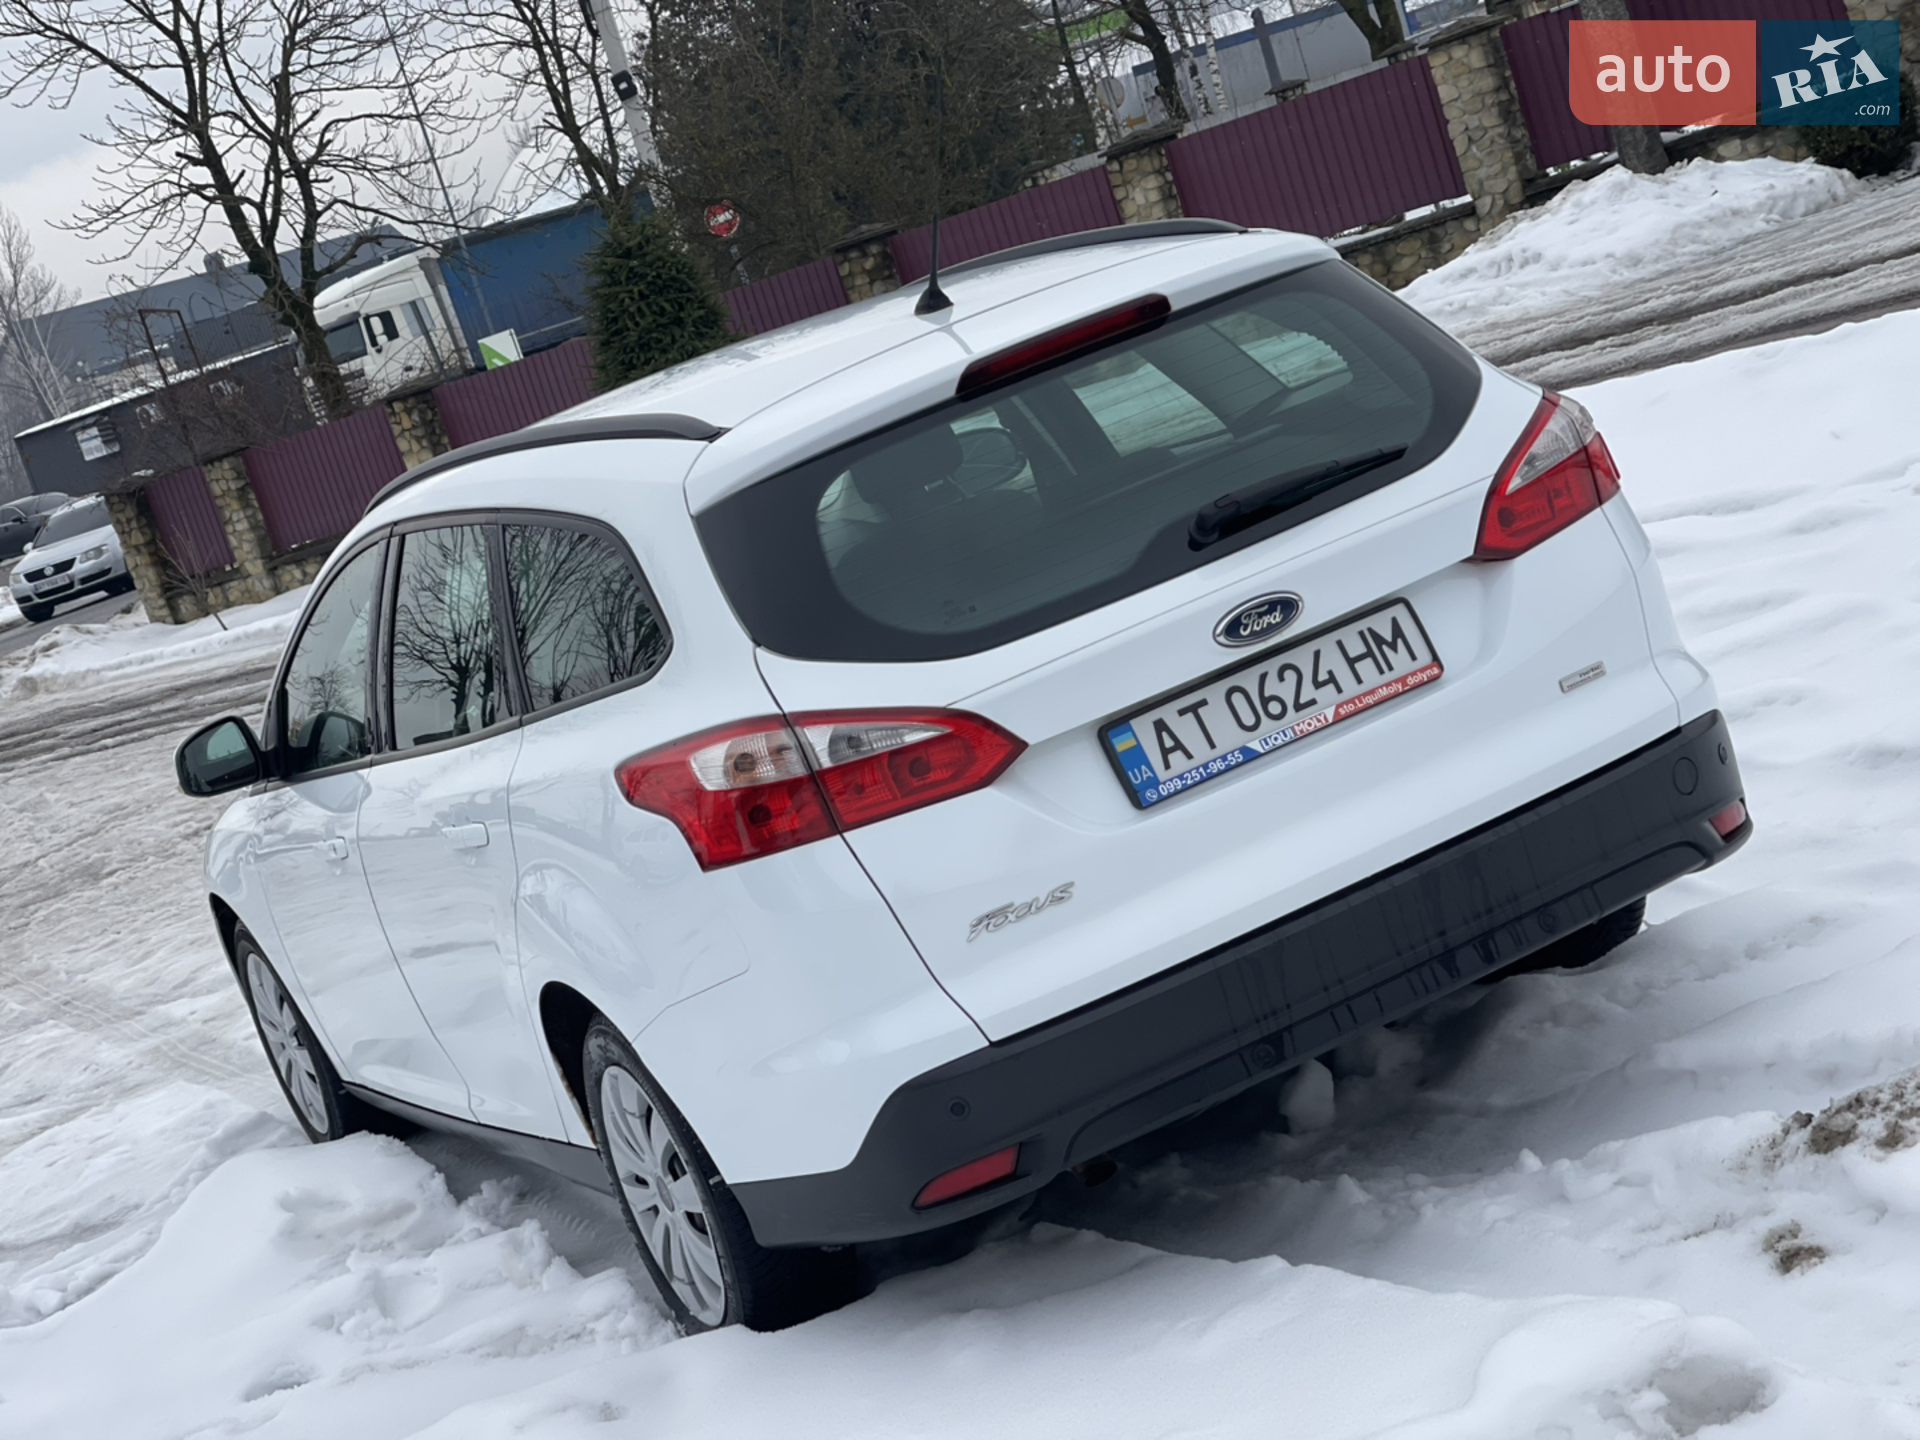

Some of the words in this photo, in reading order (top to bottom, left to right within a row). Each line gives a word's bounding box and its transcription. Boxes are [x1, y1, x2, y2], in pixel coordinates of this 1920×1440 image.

[1240, 604, 1284, 636] Ford
[1152, 698, 1217, 771] AT
[1225, 648, 1343, 732] 0624
[1336, 616, 1418, 685] HM
[1128, 764, 1154, 784] UA
[1158, 750, 1243, 796] 099-251-96-55
[1260, 727, 1295, 750] LIQUI
[1294, 712, 1327, 738] MOLY
